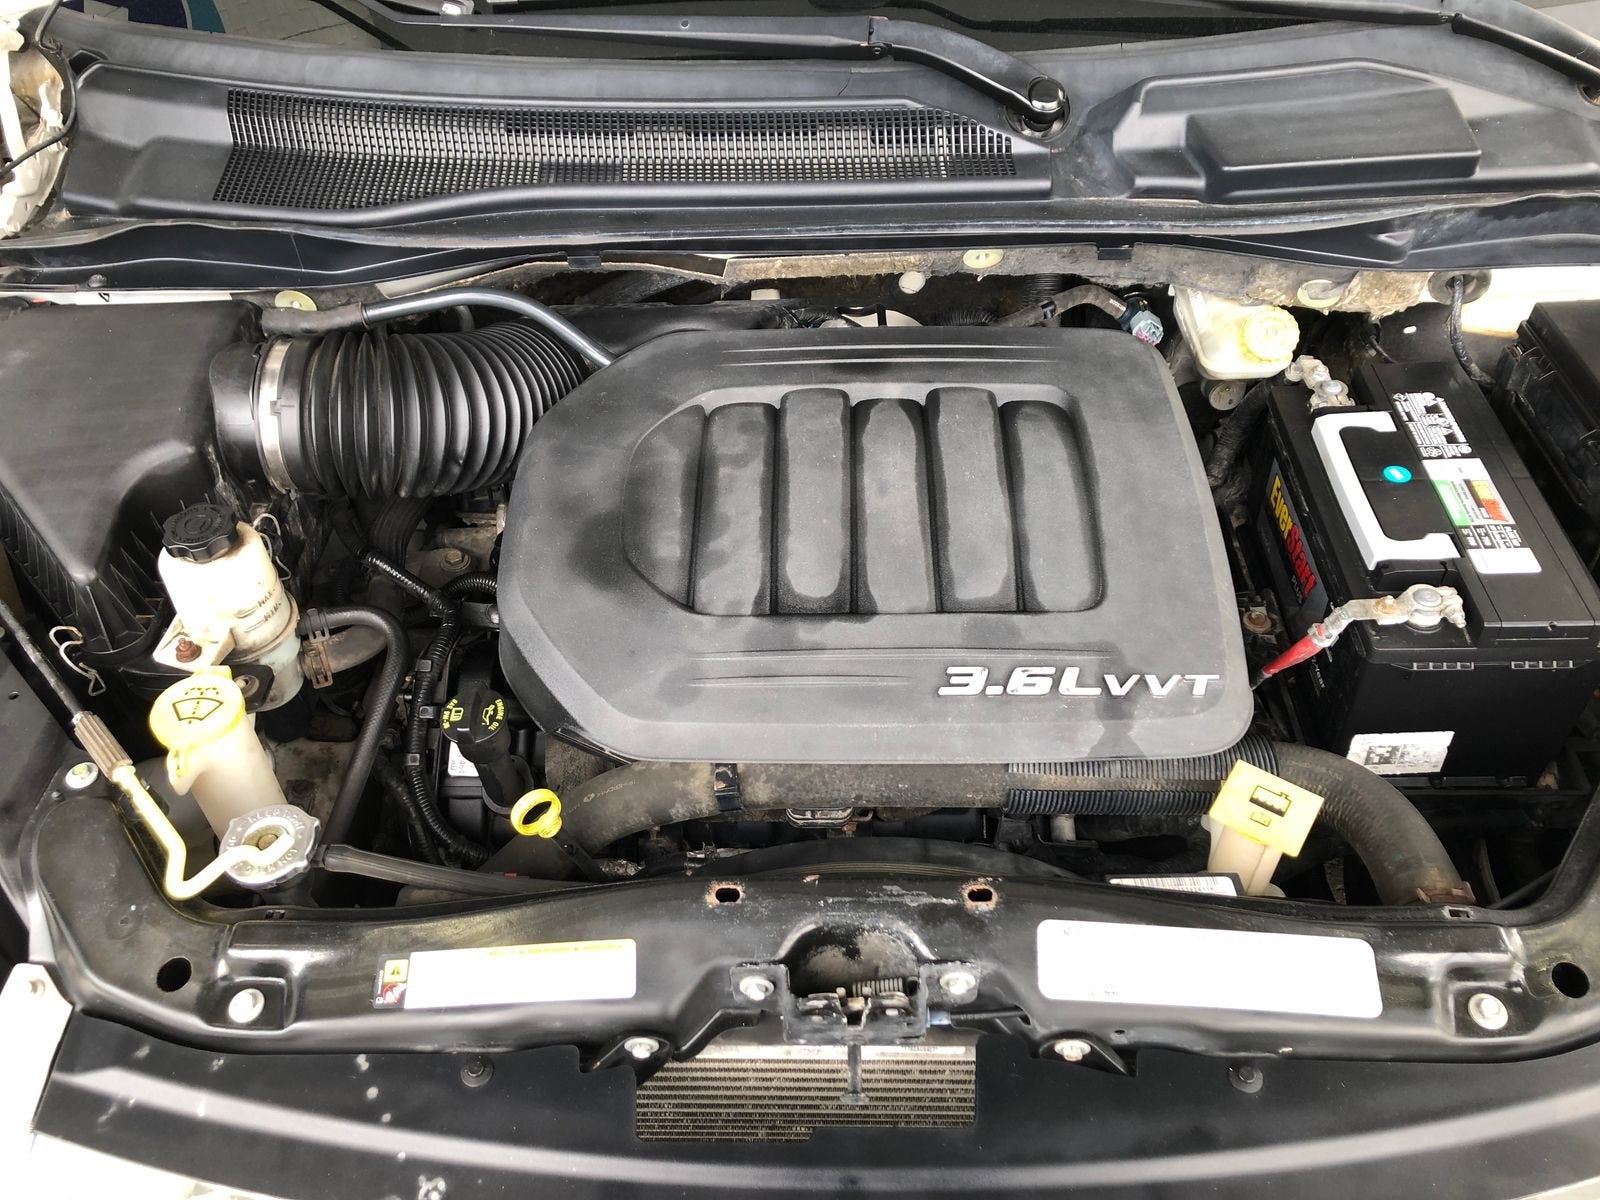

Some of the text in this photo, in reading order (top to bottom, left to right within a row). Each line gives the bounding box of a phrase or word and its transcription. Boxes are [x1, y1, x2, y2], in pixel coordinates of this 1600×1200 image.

[1270, 474, 1317, 599] EverStart
[1103, 673, 1220, 696] VVT
[487, 721, 500, 731] OIL
